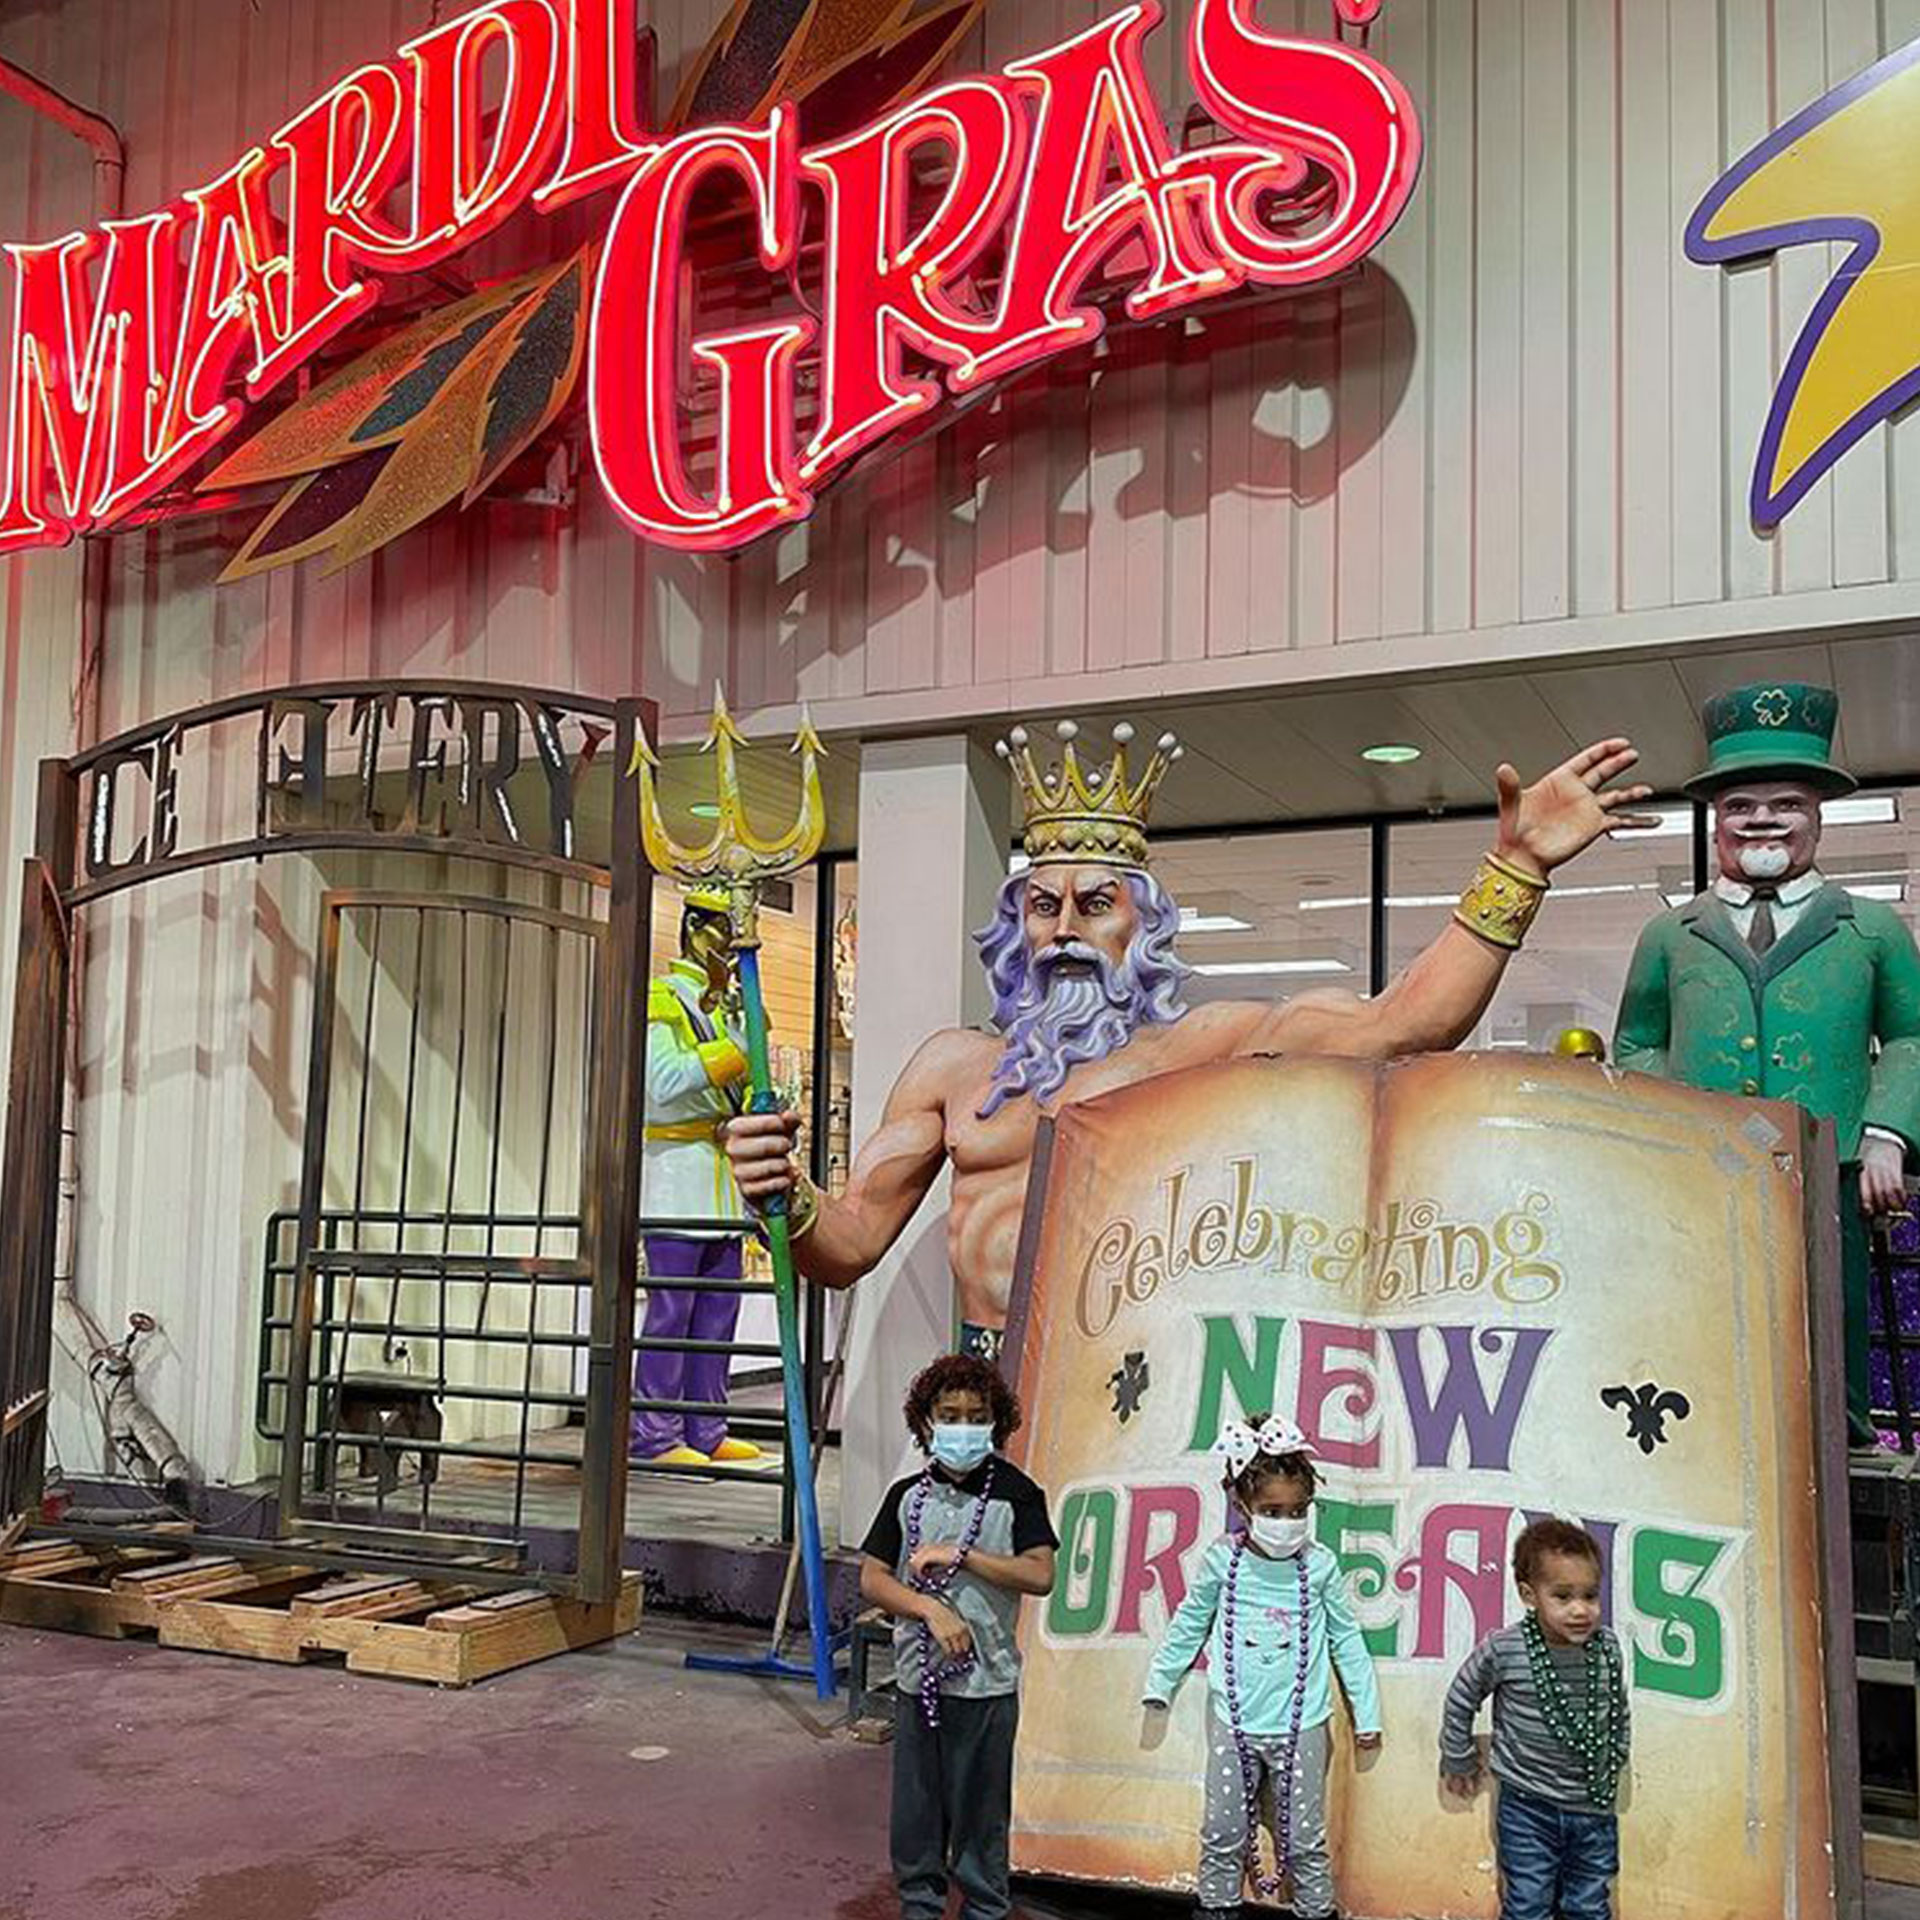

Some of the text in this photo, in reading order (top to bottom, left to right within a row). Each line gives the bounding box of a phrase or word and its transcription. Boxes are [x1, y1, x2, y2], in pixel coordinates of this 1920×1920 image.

[0, 0, 660, 550] MARDI
[588, 0, 1422, 552] GRAS
[1074, 1158, 1563, 1338] Celebrating
[1188, 1314, 1556, 1472] NEW
[1046, 1482, 1728, 1701] OREAS
